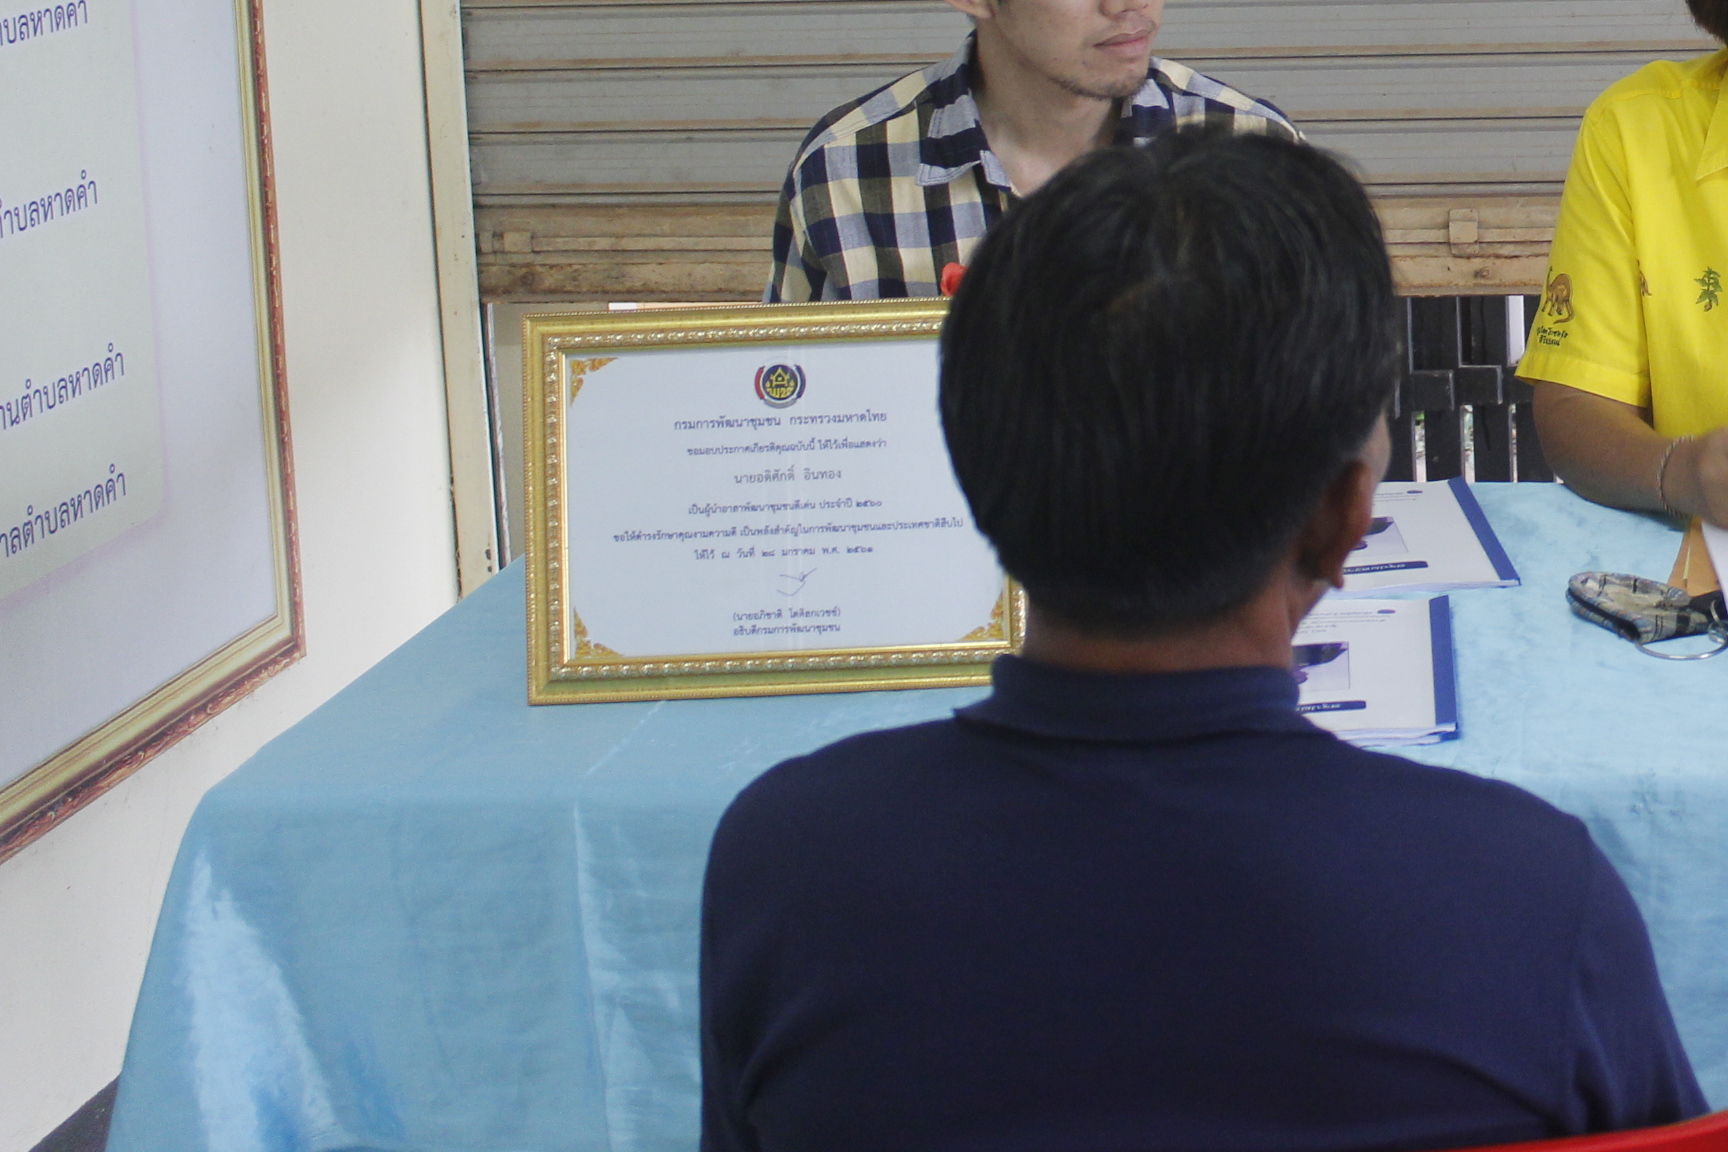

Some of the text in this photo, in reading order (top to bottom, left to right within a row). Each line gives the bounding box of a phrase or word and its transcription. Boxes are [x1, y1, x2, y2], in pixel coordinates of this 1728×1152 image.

[674, 408, 887, 431] กรมการพัฒนาชุมชน กระทรวงมหาดไทย
[803, 467, 842, 481] อินทอง
